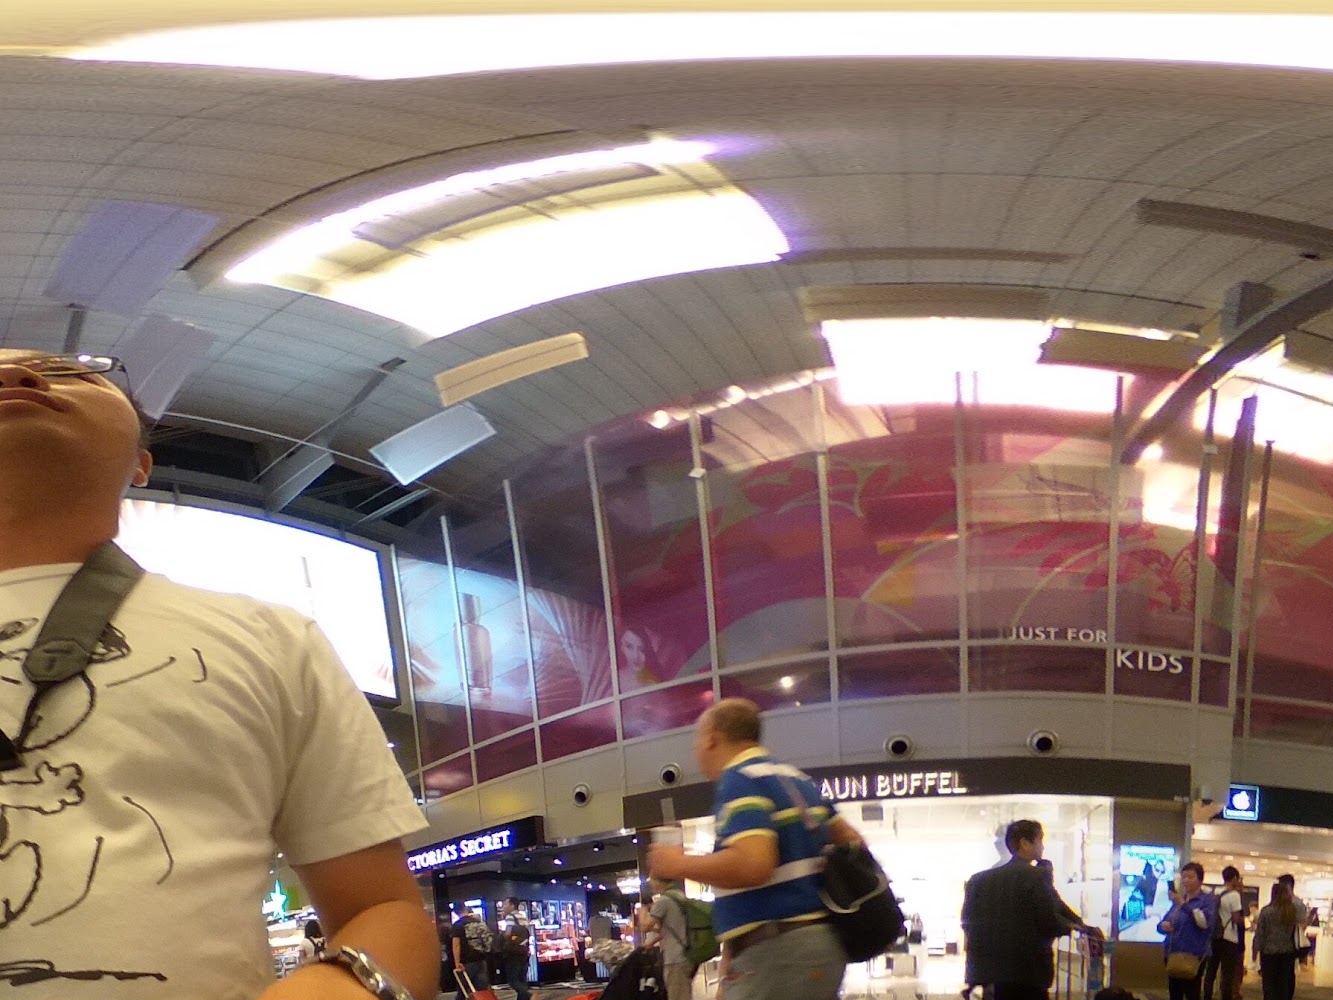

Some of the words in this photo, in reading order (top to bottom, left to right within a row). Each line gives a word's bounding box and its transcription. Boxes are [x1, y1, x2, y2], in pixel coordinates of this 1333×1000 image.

[1011, 626, 1058, 641] JUST
[1067, 628, 1107, 643] FOR
[1117, 649, 1183, 674] KIDS
[821, 774, 868, 800] AUN
[407, 844, 458, 870] CTORIA'S
